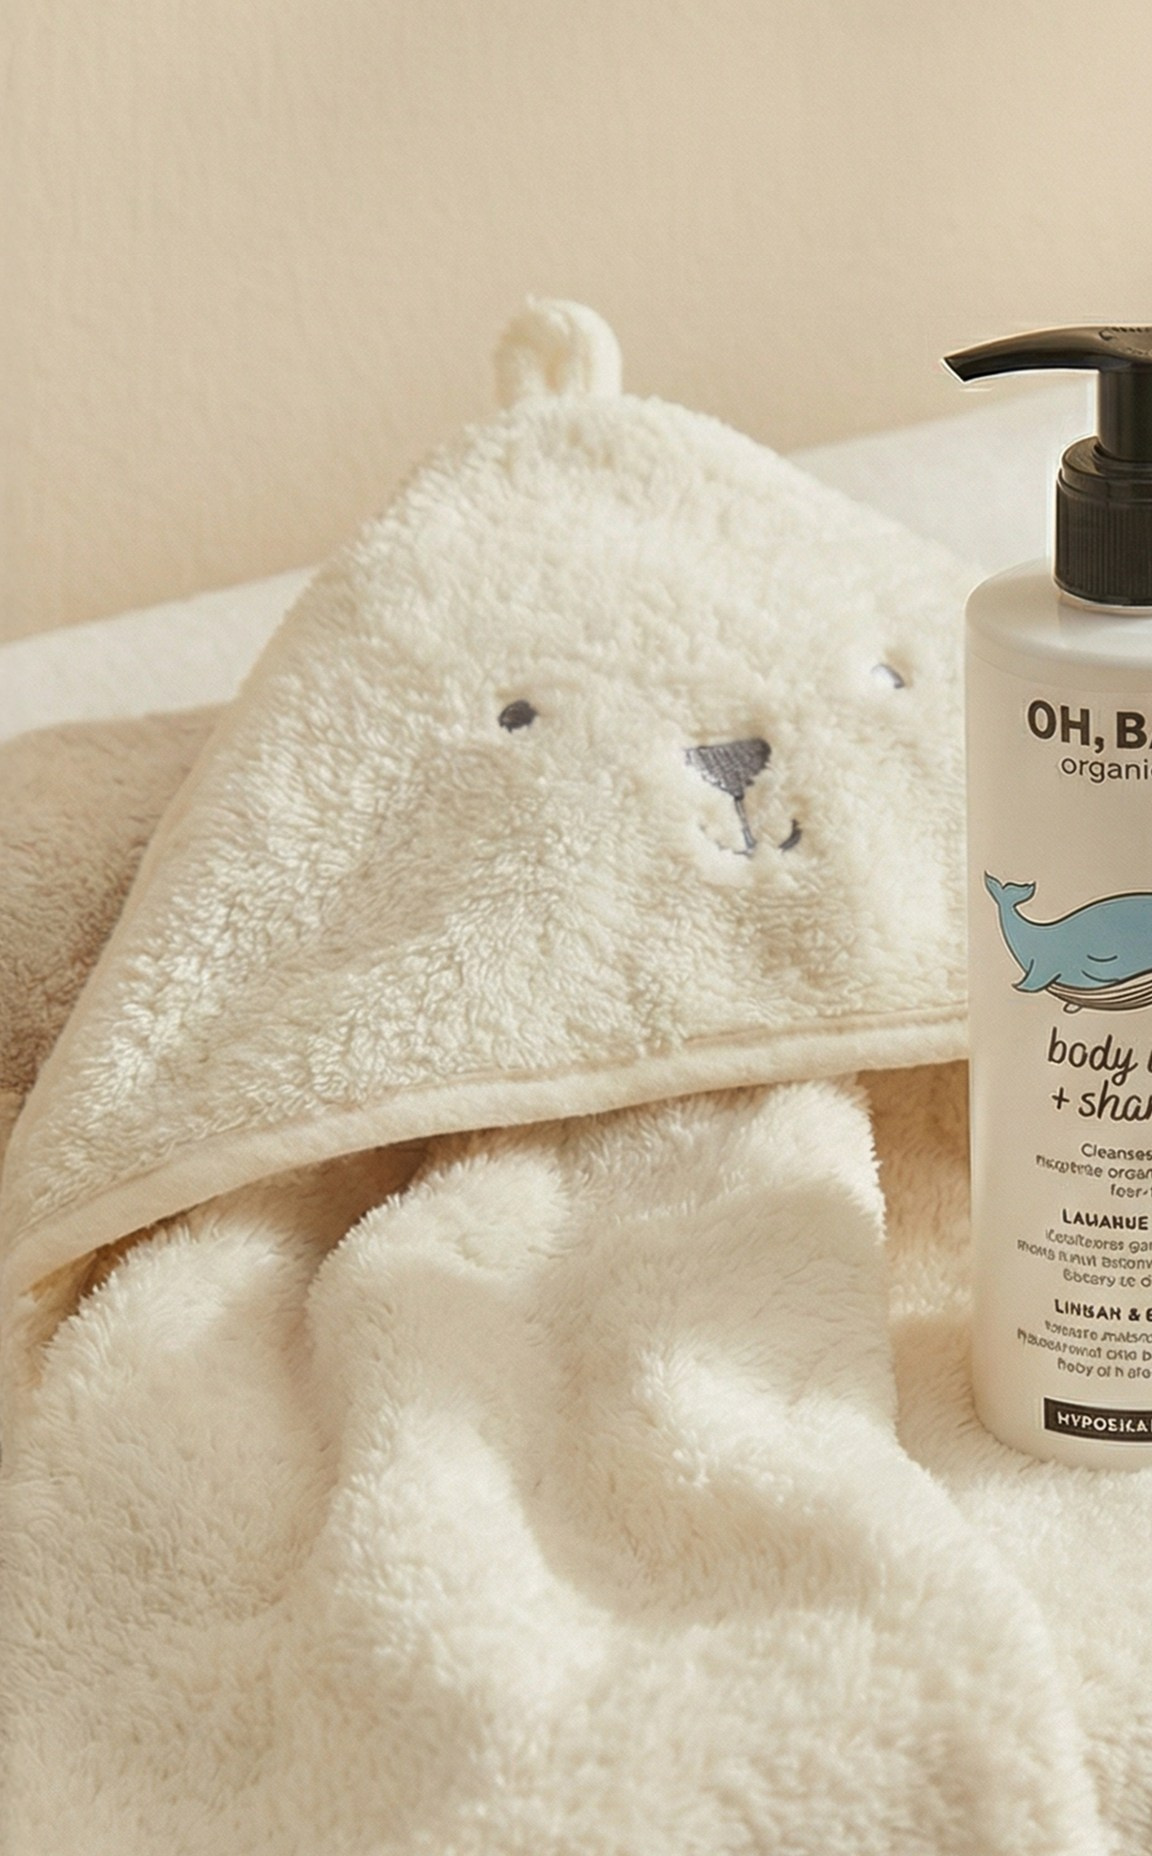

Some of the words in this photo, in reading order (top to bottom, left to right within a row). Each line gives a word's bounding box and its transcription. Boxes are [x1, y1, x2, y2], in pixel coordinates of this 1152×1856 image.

[1027, 699, 1105, 753] OH,
[1047, 1026, 1139, 1087] body
[1128, 1307, 1141, 1321] &
